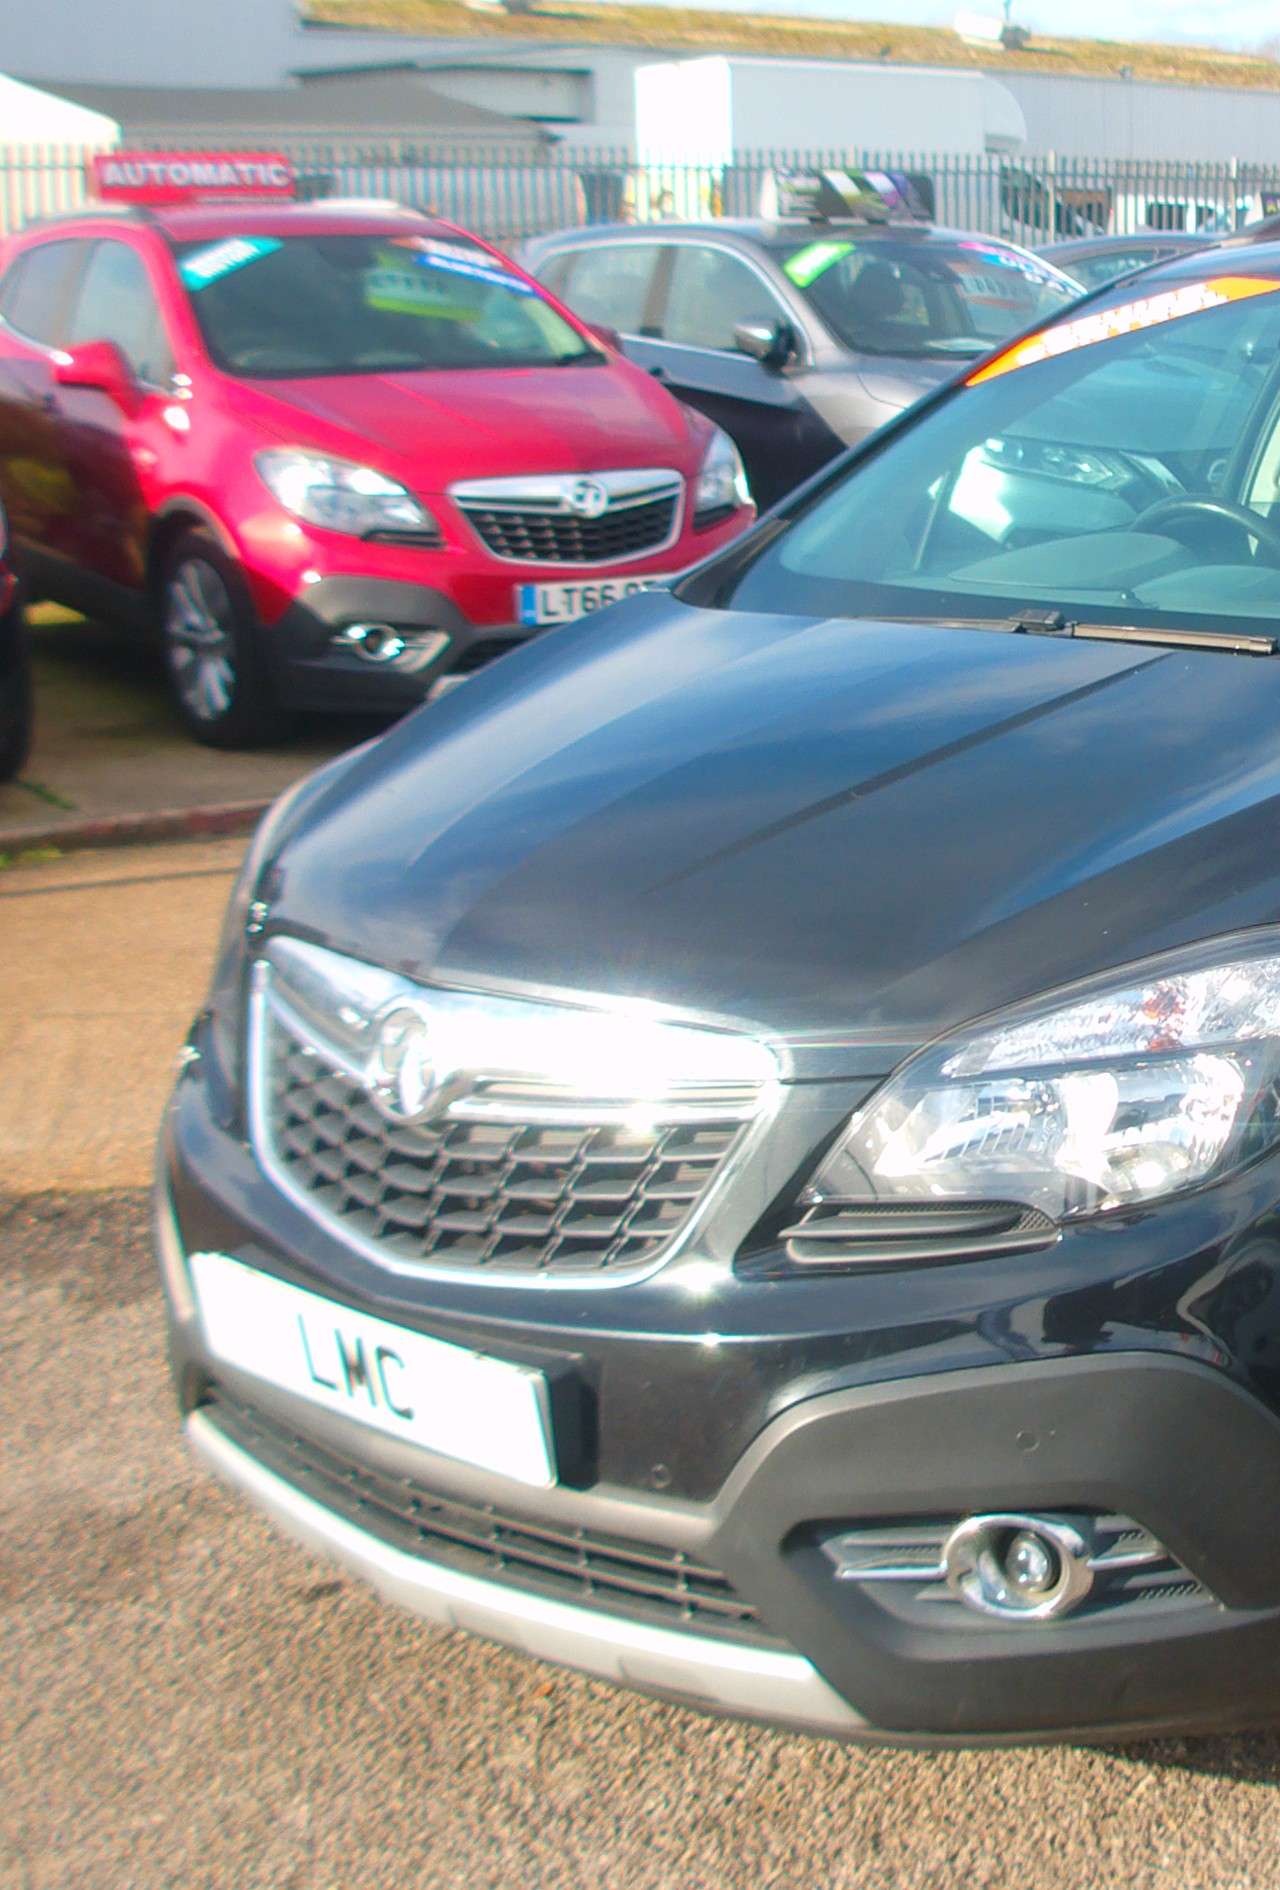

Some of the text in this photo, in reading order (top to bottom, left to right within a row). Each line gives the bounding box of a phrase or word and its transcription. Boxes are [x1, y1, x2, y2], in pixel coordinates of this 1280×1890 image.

[103, 161, 289, 187] AUTOMATIC
[541, 585, 616, 616] LT66
[296, 1313, 415, 1421] LMC
